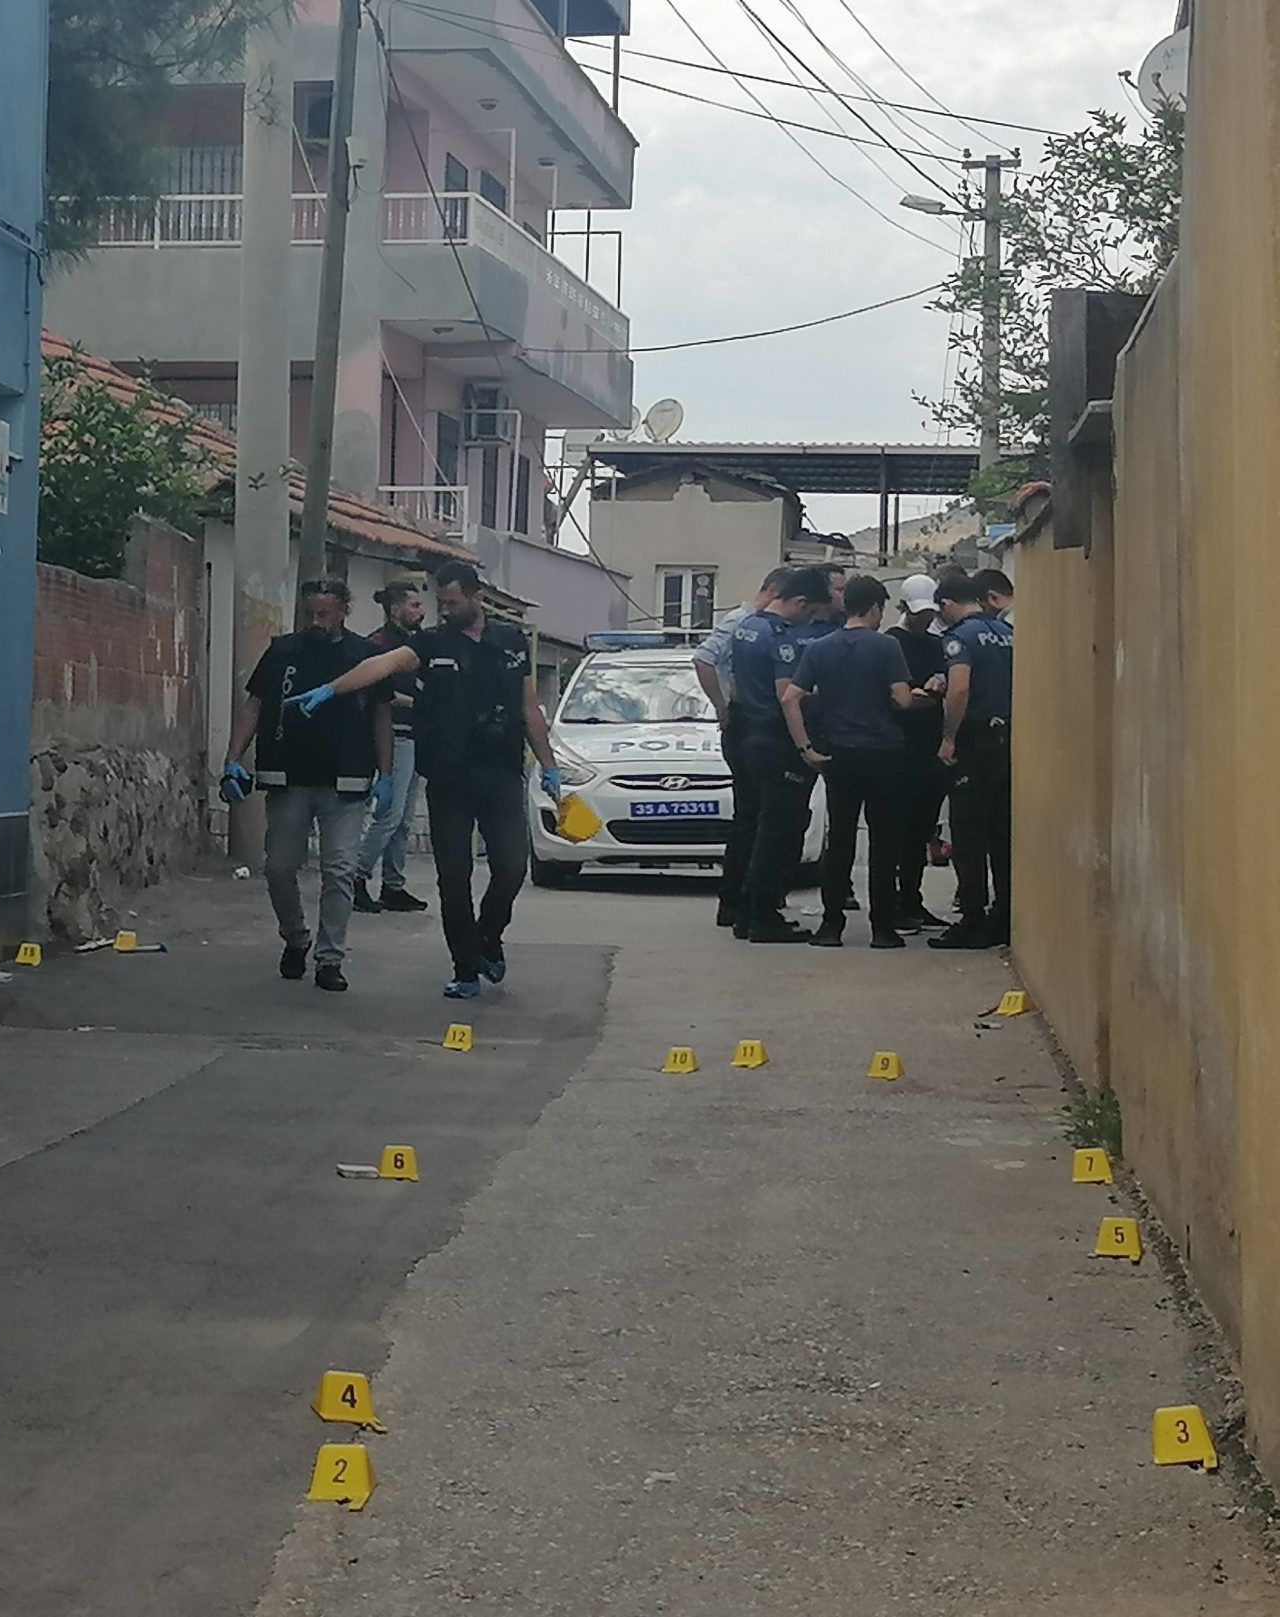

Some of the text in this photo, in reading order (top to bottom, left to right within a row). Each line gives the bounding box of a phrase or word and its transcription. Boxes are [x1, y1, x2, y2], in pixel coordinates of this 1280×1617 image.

[610, 740, 722, 753] POLI
[635, 802, 715, 815] 35 A 73311
[451, 1030, 466, 1043] 12
[672, 1053, 687, 1065] 10
[742, 1046, 754, 1057] 11
[879, 1057, 891, 1072] 9
[393, 1152, 405, 1170] 6
[1085, 1156, 1094, 1172] 7
[1114, 1226, 1125, 1245] 5
[340, 1383, 358, 1409] 4
[1175, 1419, 1190, 1444] 3
[332, 1458, 348, 1484] 2
